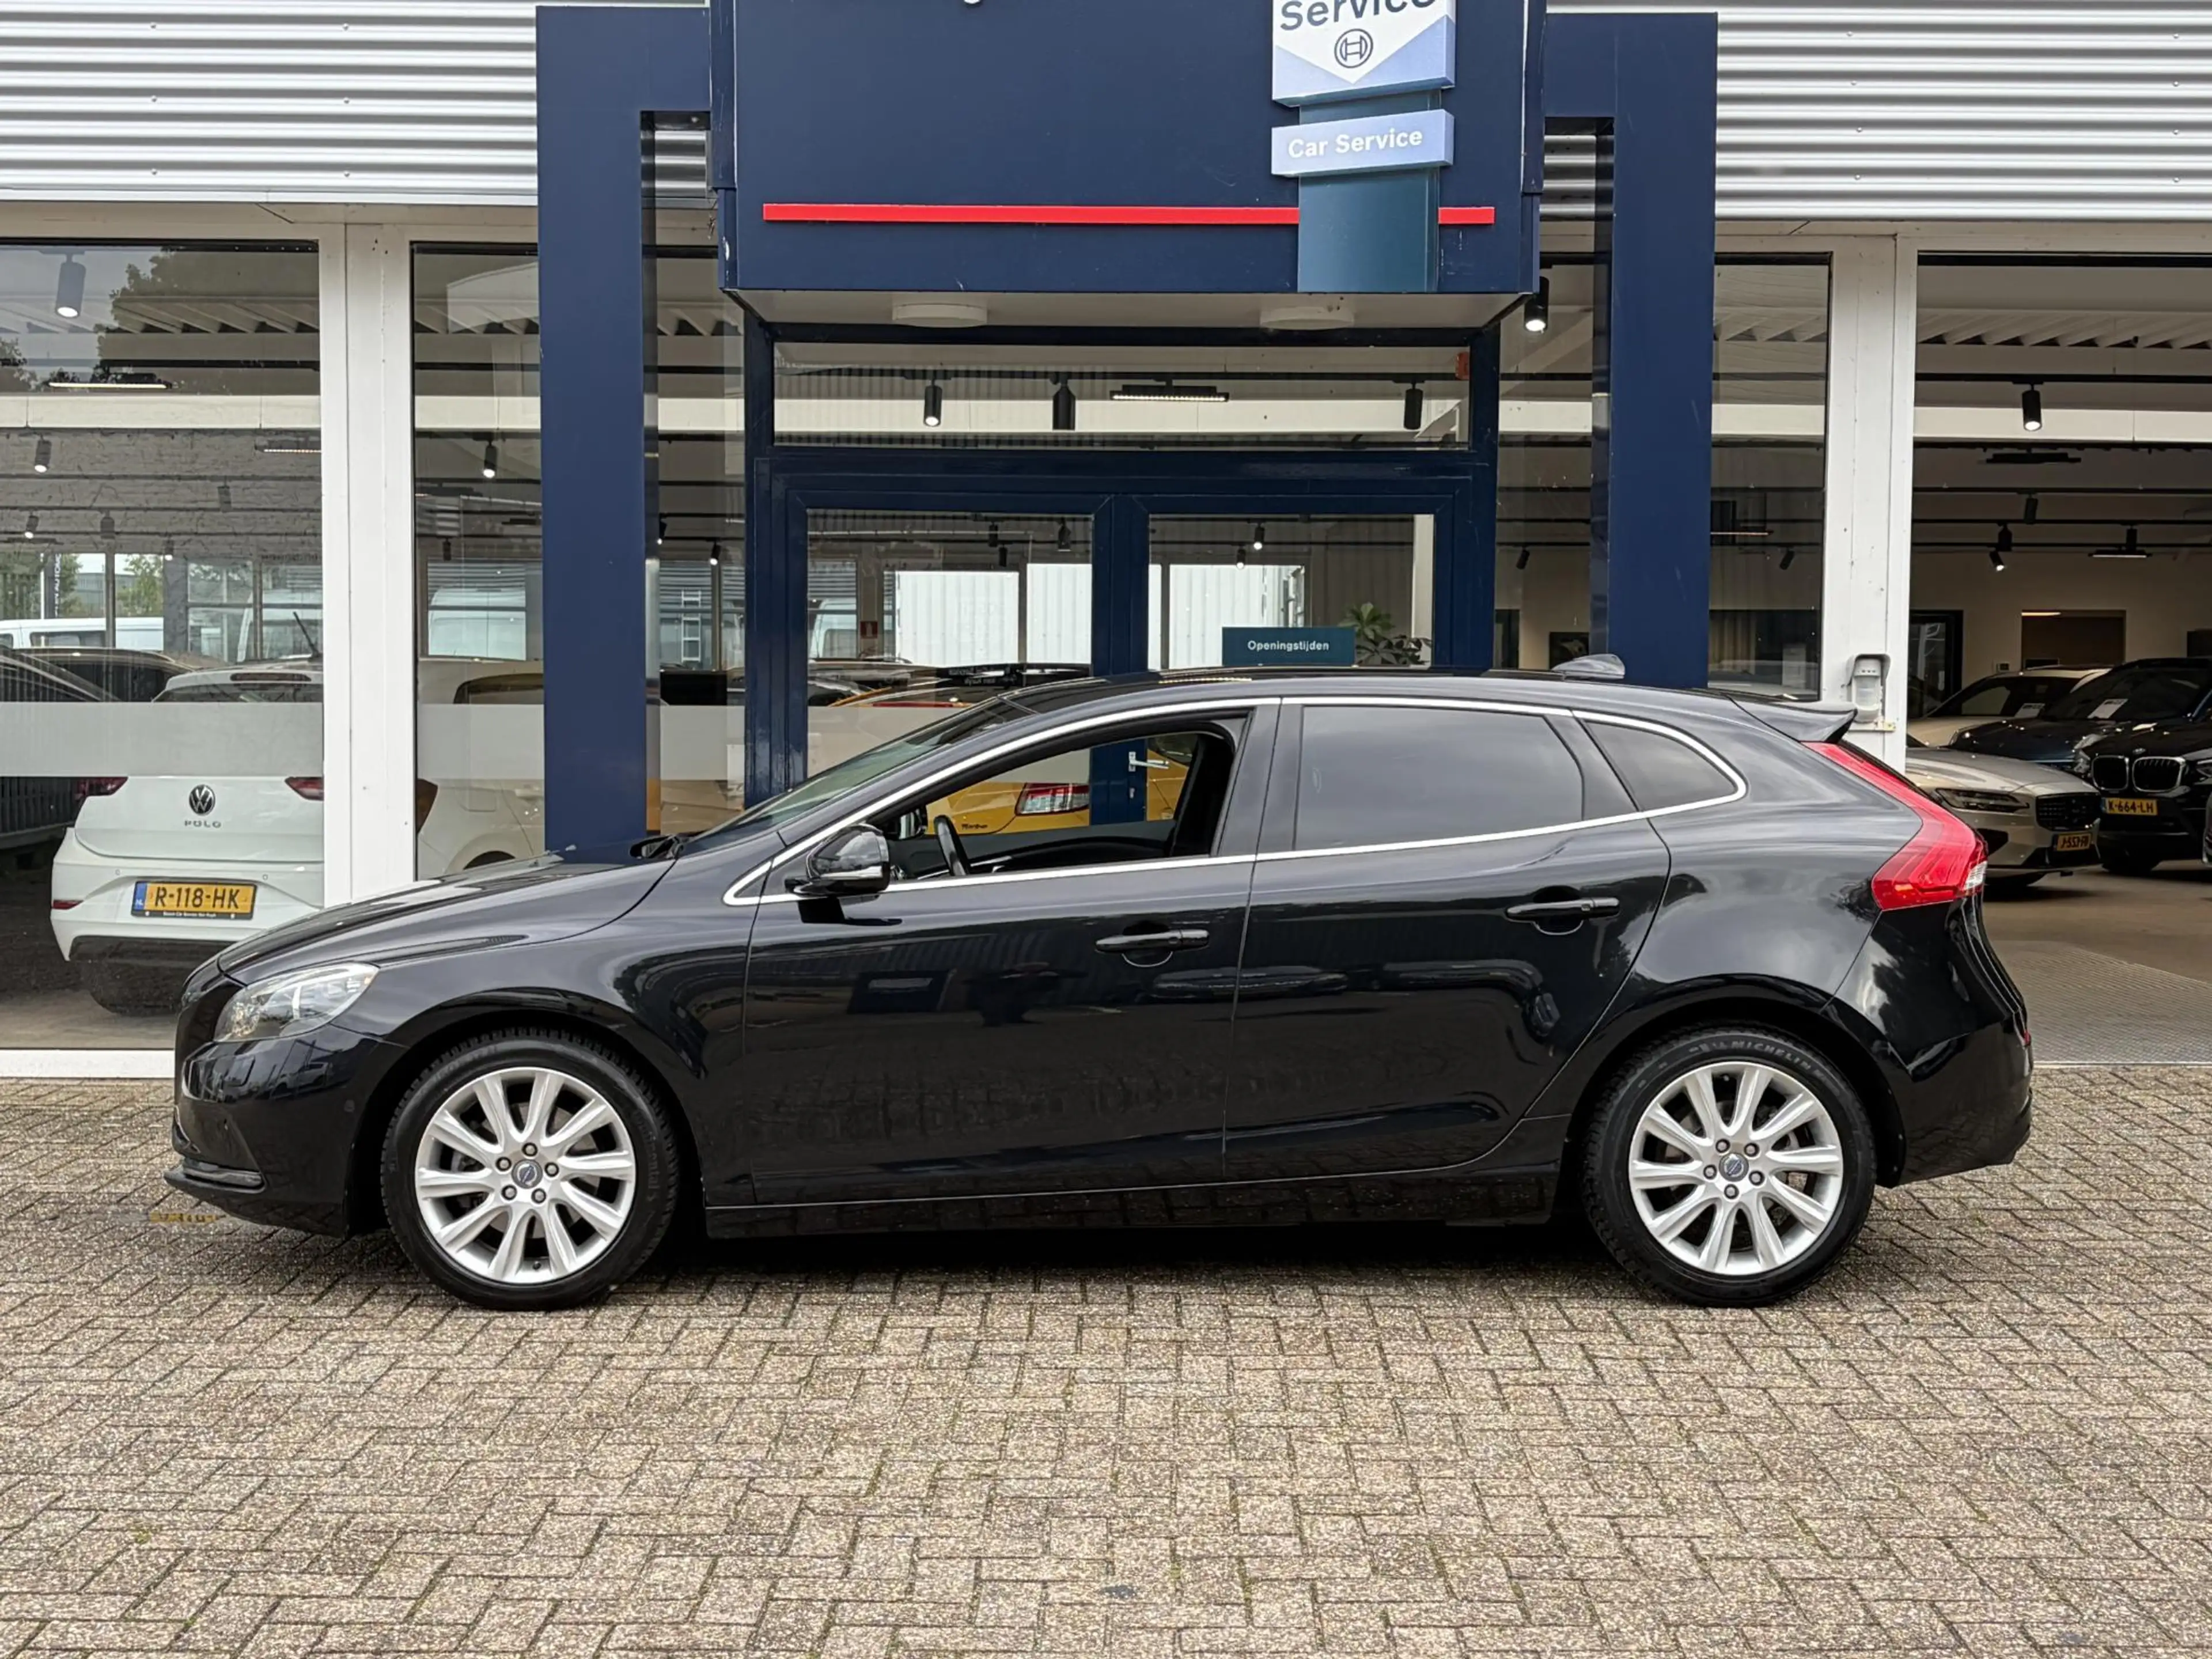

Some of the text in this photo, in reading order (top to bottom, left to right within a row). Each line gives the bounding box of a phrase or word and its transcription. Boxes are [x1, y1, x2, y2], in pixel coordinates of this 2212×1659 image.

[1288, 127, 1423, 158] Car Service
[1247, 640, 1330, 652] Openingstijden
[2108, 800, 2154, 813] K-664-LH
[184, 820, 221, 828] POLO
[154, 886, 240, 910] R-118-HK
[1731, 1040, 1811, 1070] MICHELIN
